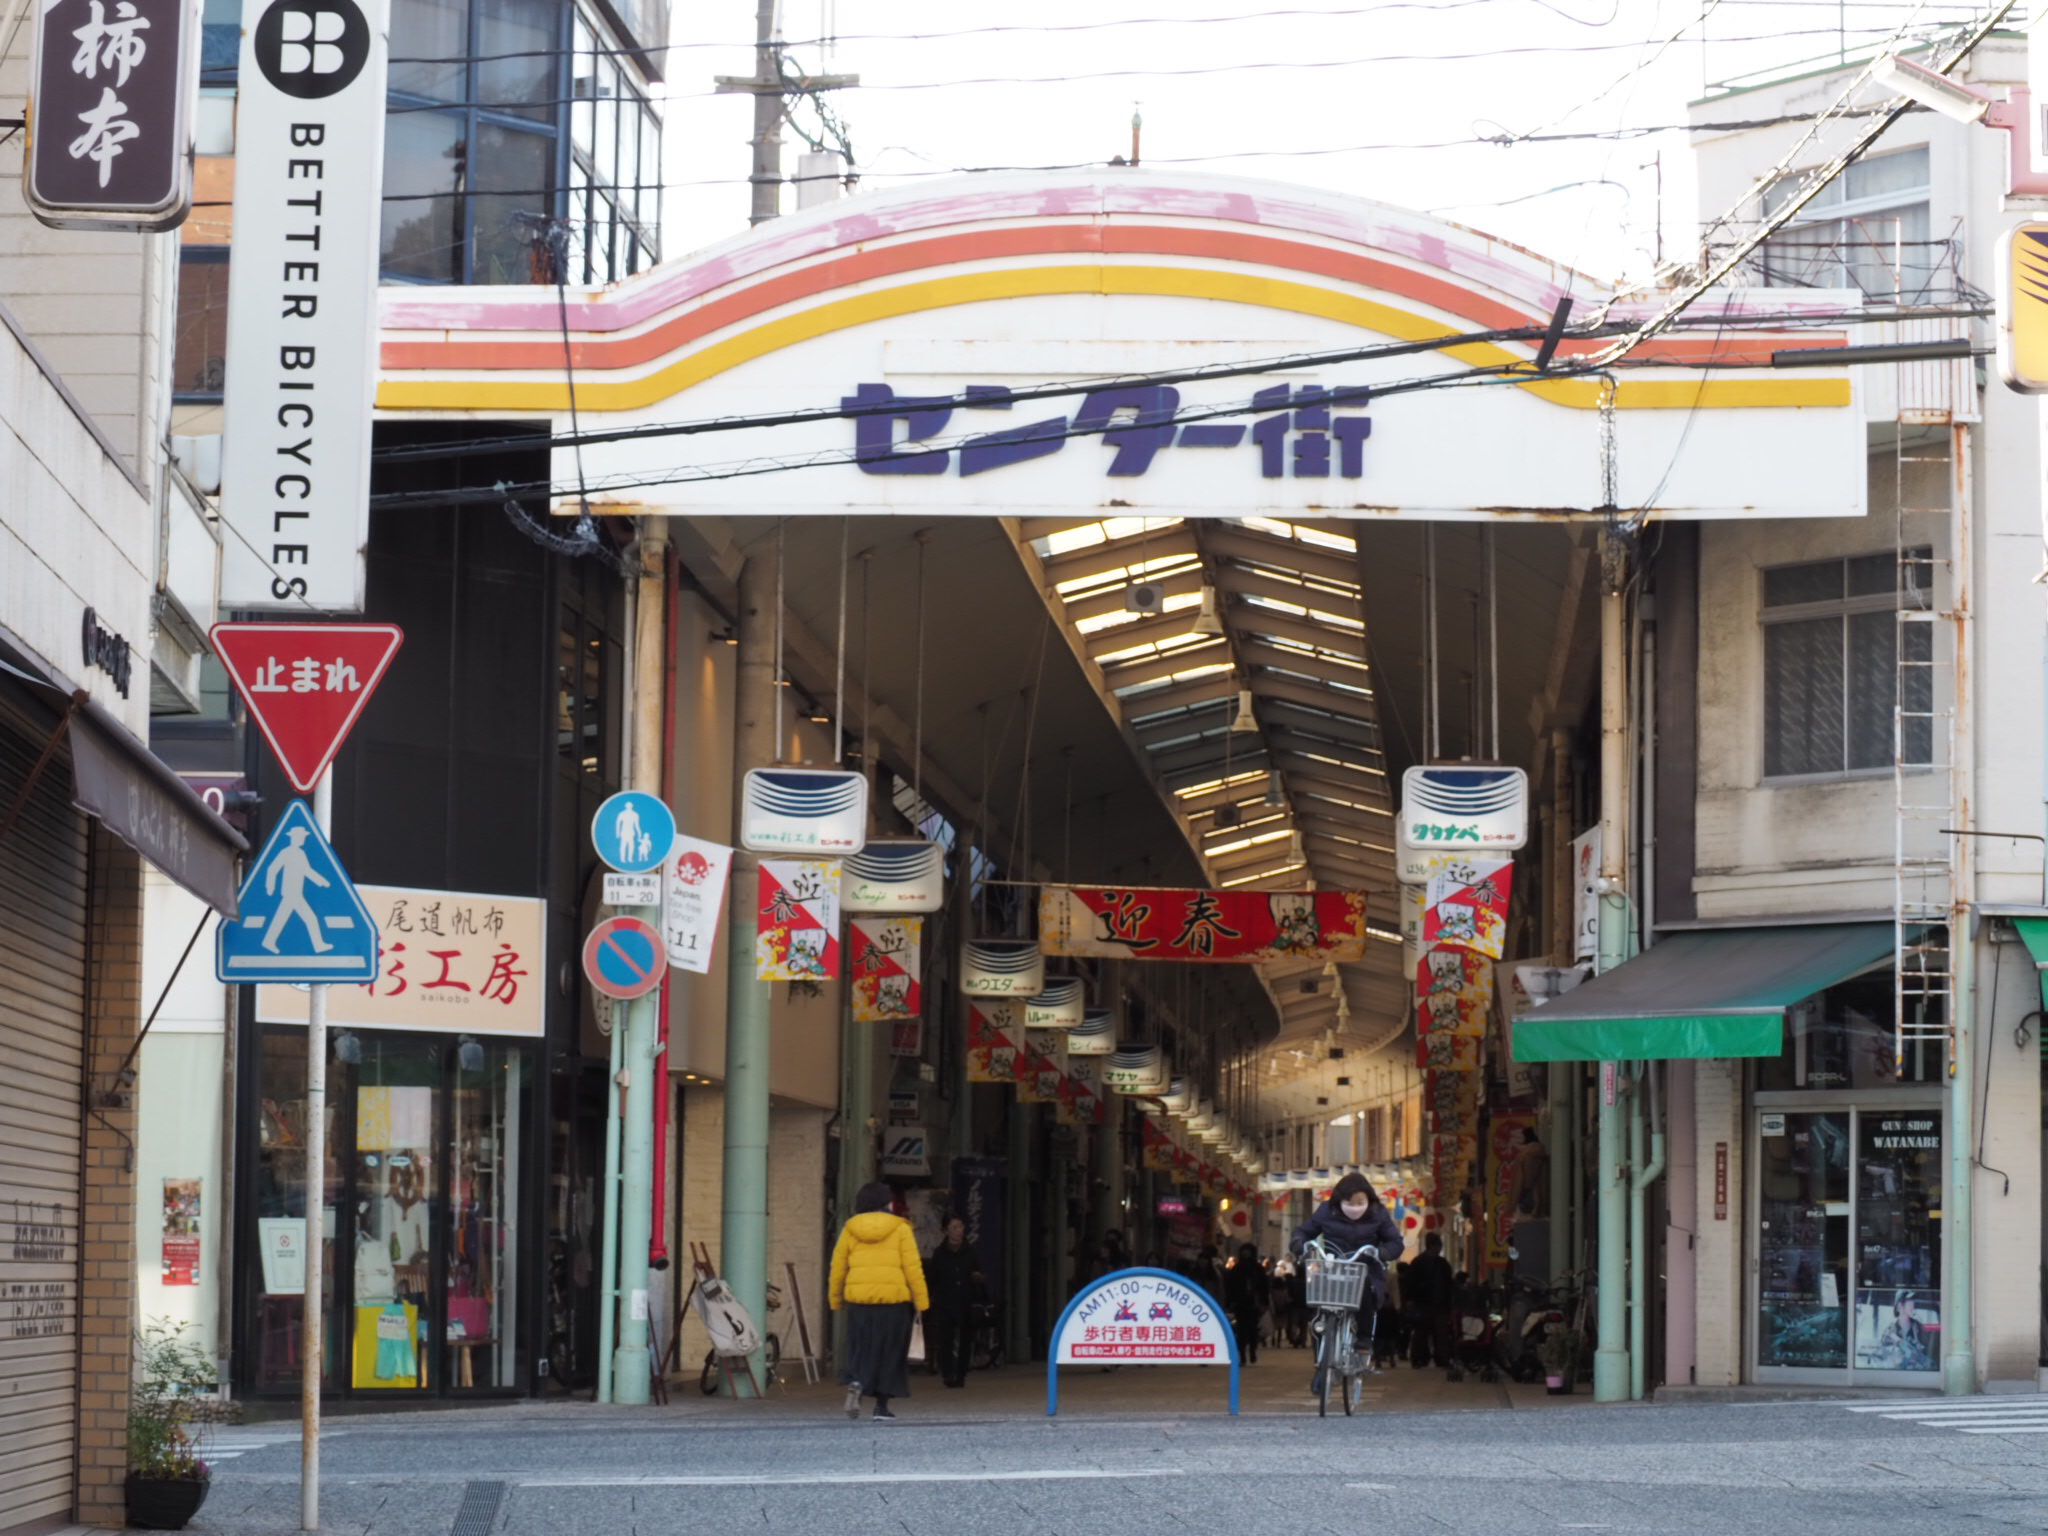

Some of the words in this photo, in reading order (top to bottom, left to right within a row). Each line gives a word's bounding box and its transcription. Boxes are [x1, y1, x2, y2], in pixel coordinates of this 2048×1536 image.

[69, 0, 151, 189] 柿本
[281, 122, 326, 321] BETTER
[841, 382, 1372, 478] センター街
[271, 346, 316, 600] BICYCLES
[250, 656, 362, 693] 止まれ
[1412, 824, 1480, 842] ワタナベ
[386, 900, 505, 940] 尾道帆布
[1095, 891, 1240, 955] 迎春
[419, 993, 471, 1005] saikobo
[1873, 1136, 1940, 1149] WATANABE
[1907, 1120, 1934, 1131] SHOP
[1084, 1325, 1203, 1342] 歩行者専用道路
